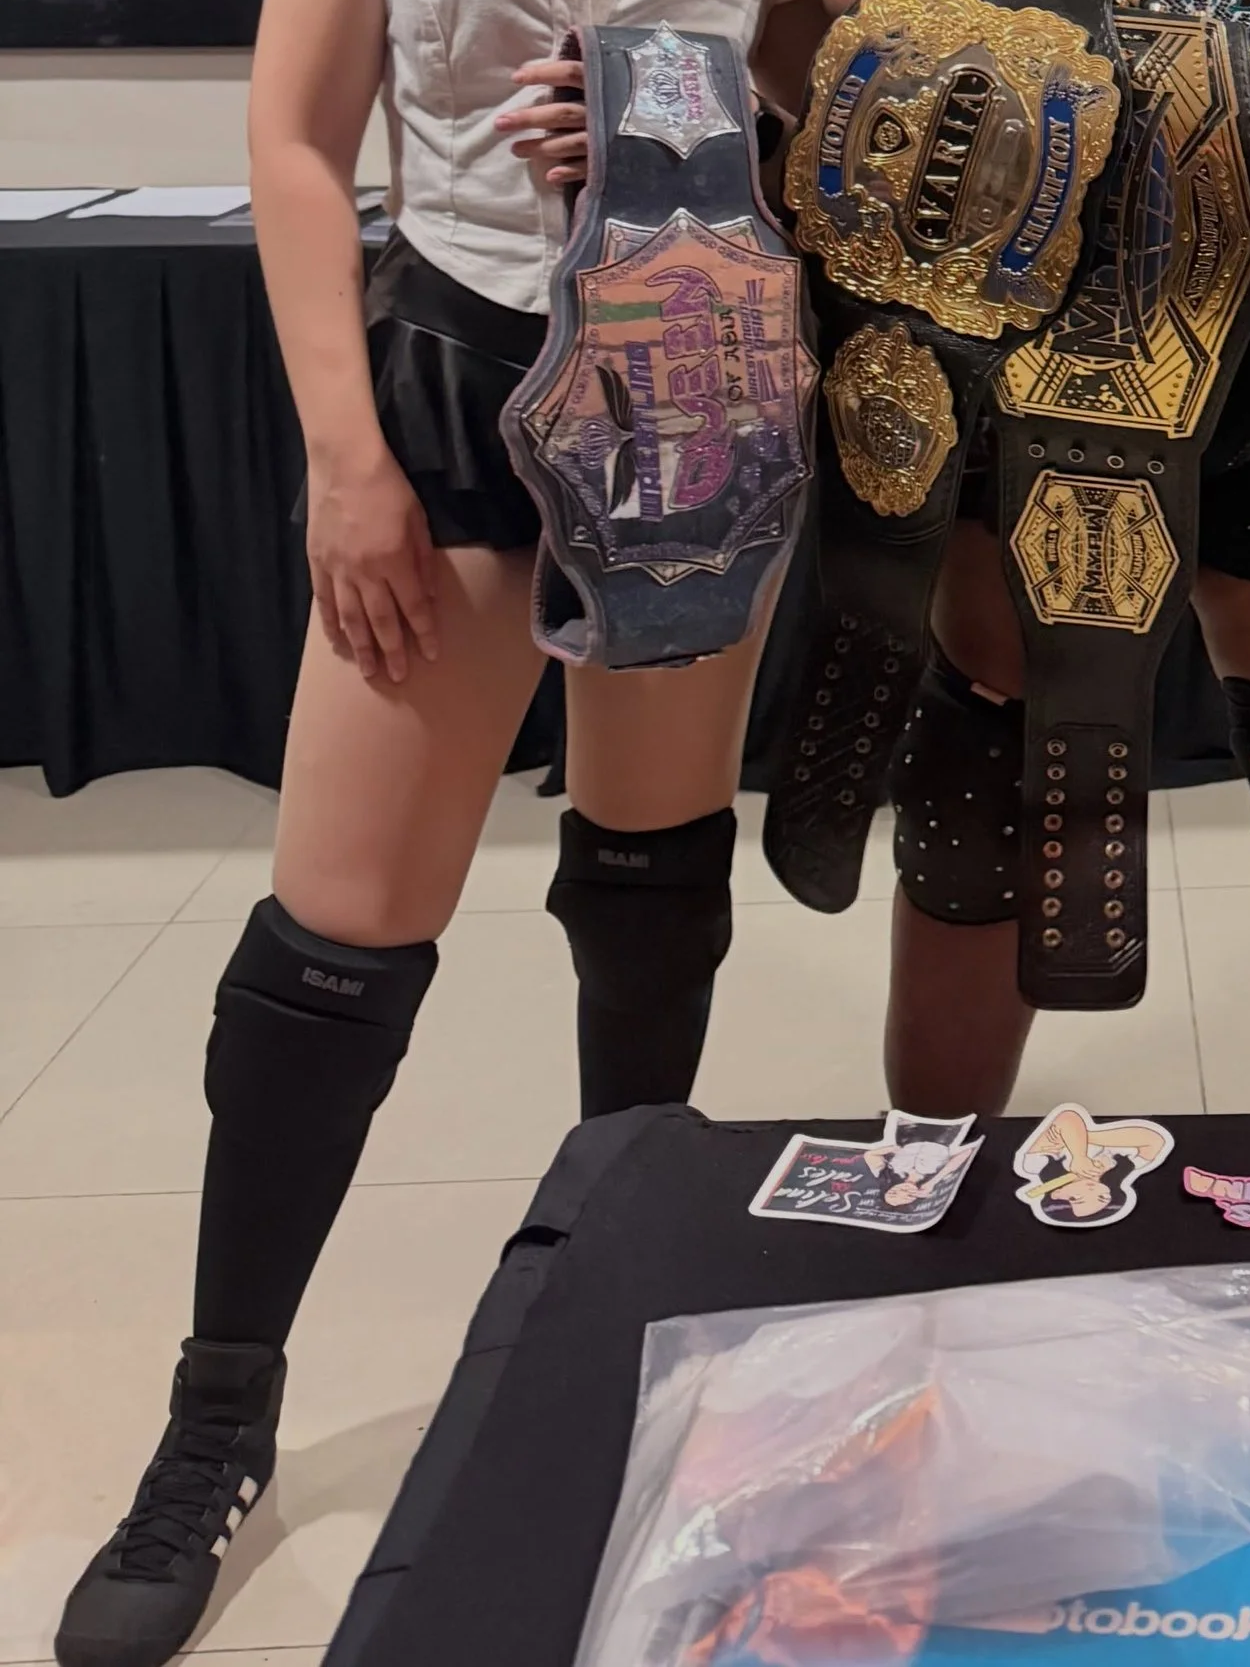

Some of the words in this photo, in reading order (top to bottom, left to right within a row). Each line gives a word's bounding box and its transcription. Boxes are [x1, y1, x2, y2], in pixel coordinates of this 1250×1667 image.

[820, 77, 866, 167] WORLD
[916, 92, 985, 221] VARIA
[1014, 116, 1071, 255] CHAMPION
[643, 264, 737, 510] QUEEN
[302, 966, 365, 997] ISAMI
